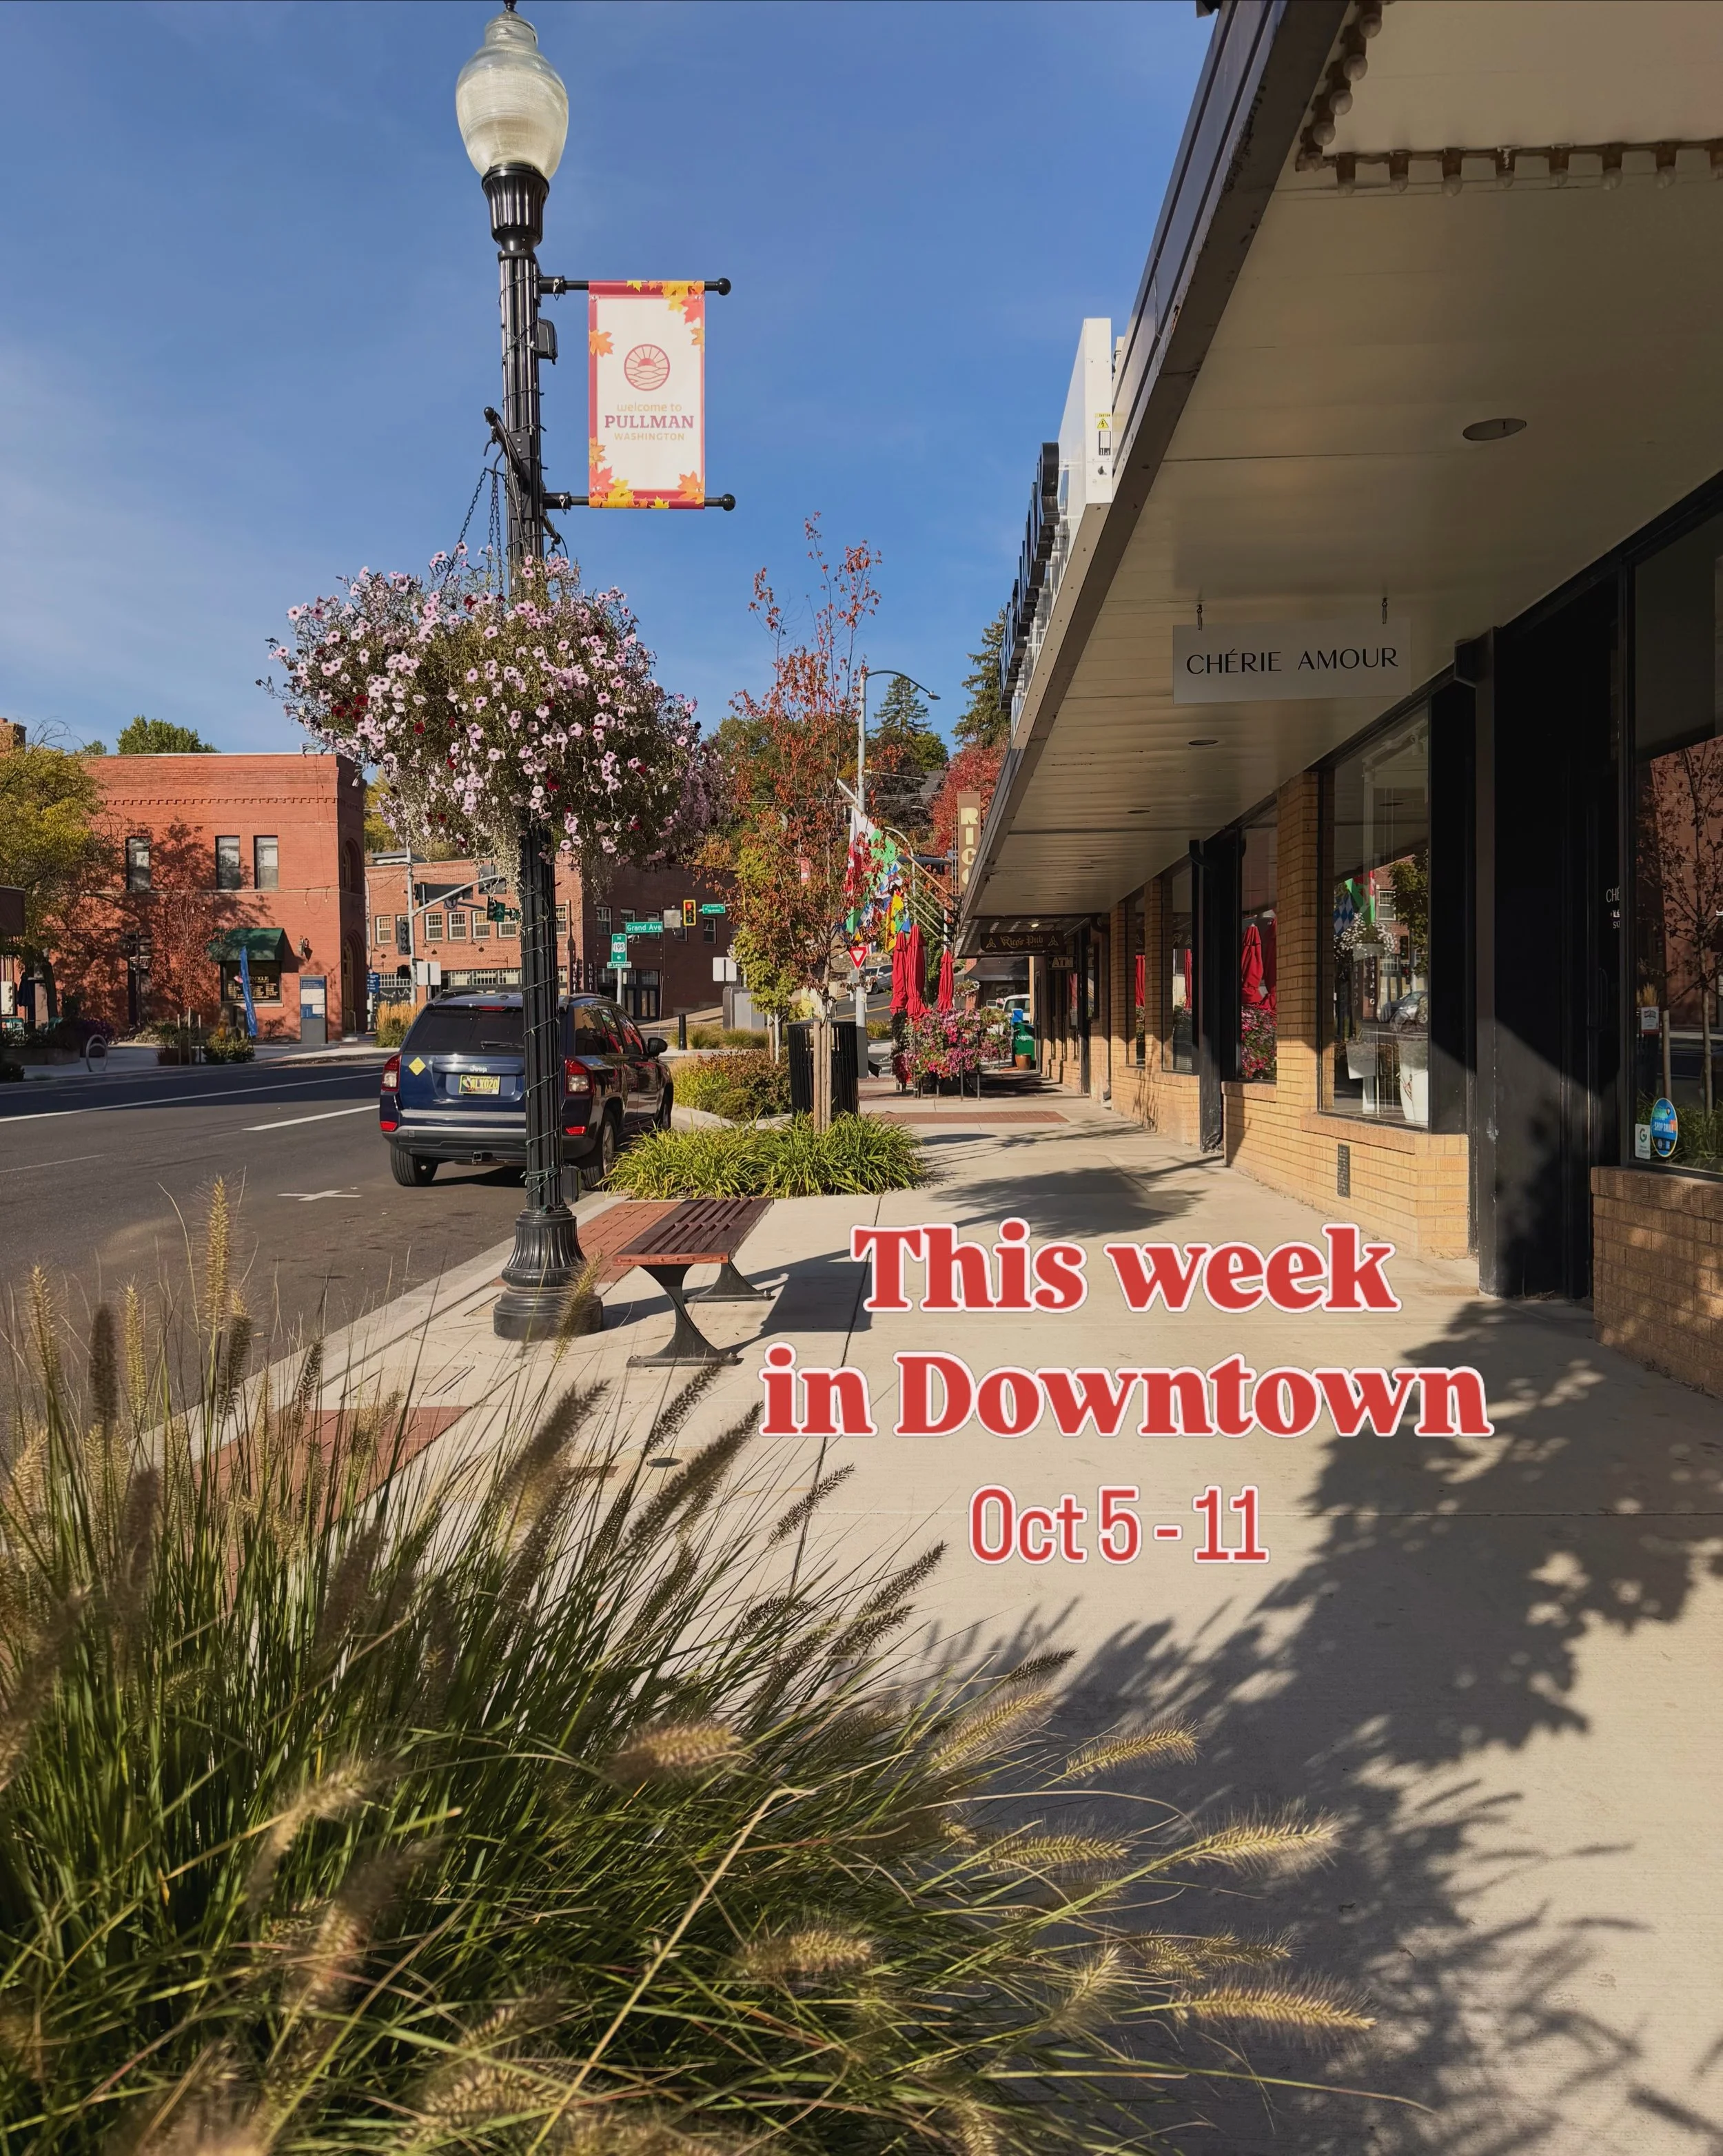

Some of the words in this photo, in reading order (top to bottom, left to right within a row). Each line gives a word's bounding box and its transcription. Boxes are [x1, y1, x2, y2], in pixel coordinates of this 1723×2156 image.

[617, 403, 667, 412] welcome
[671, 403, 682, 412] to
[604, 415, 694, 429] PULLMAN
[614, 432, 684, 441] WASHINGTON
[1186, 649, 1282, 674] CHÉRIE
[1298, 647, 1398, 670] AMOUR
[1026, 935, 1043, 946] Pub
